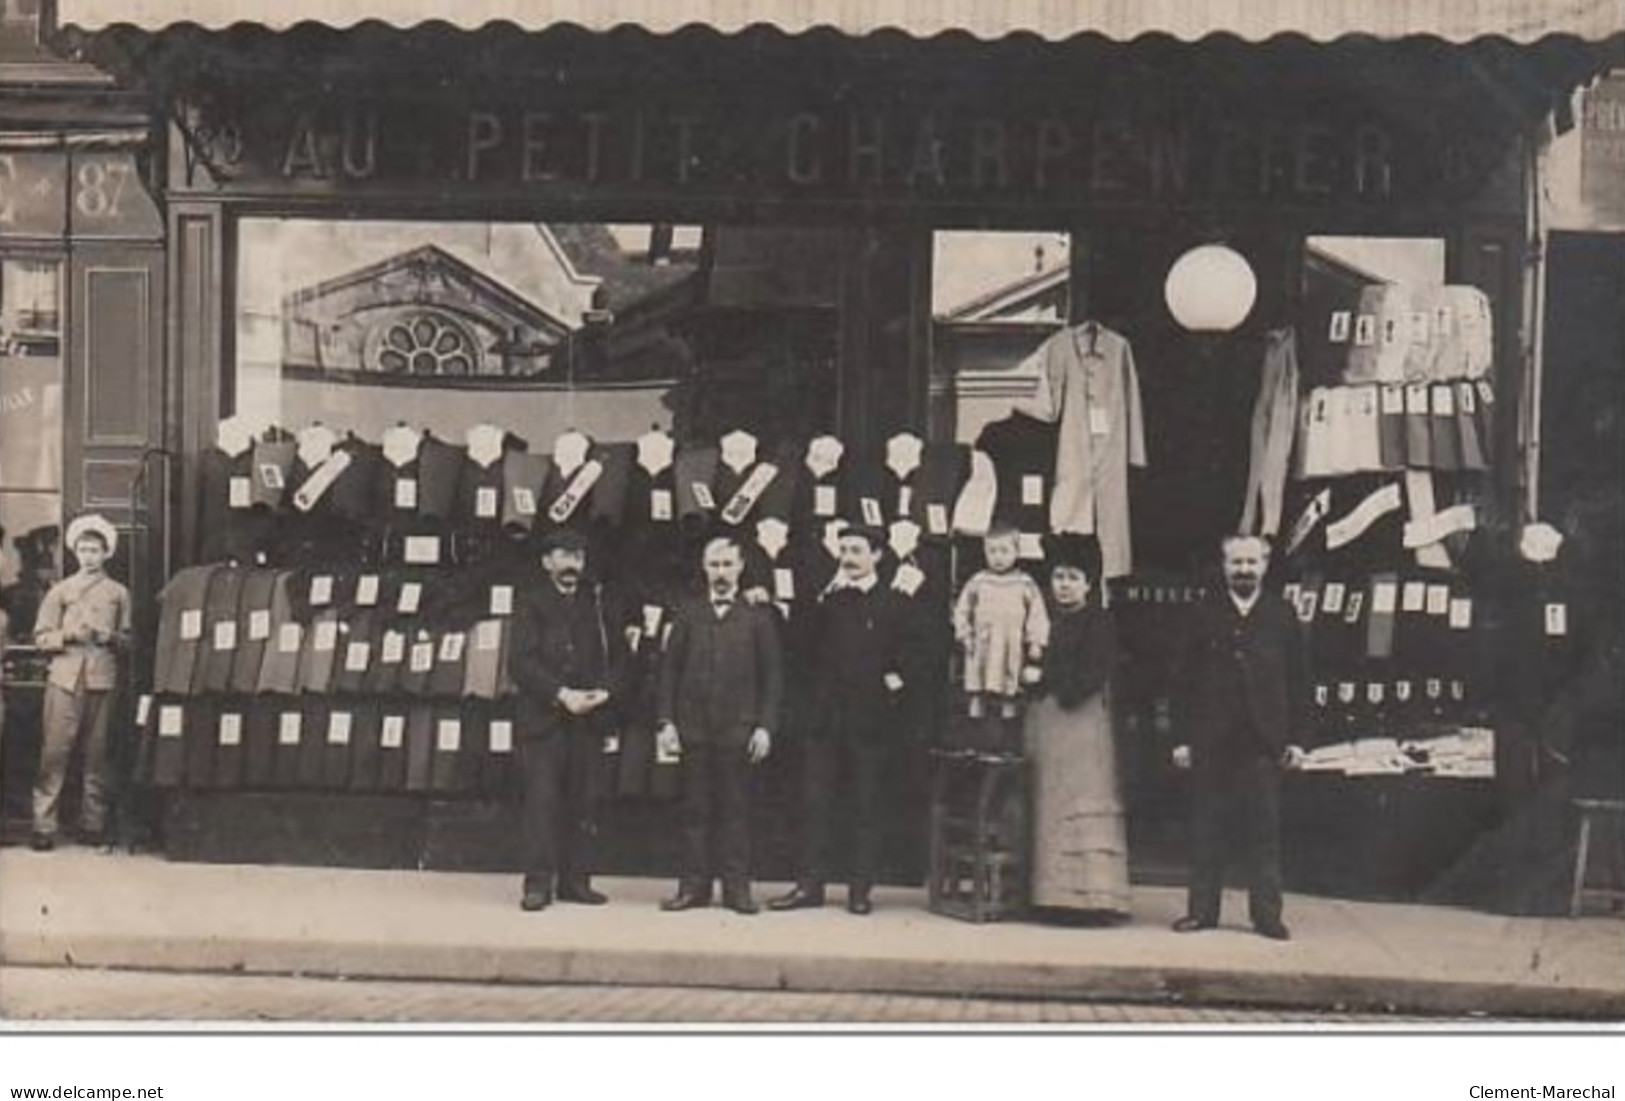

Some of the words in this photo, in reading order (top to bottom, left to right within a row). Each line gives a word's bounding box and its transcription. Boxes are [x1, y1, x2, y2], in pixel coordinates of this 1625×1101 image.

[283, 112, 377, 177] AU
[467, 109, 702, 182] PETIT
[77, 163, 129, 217] 87
